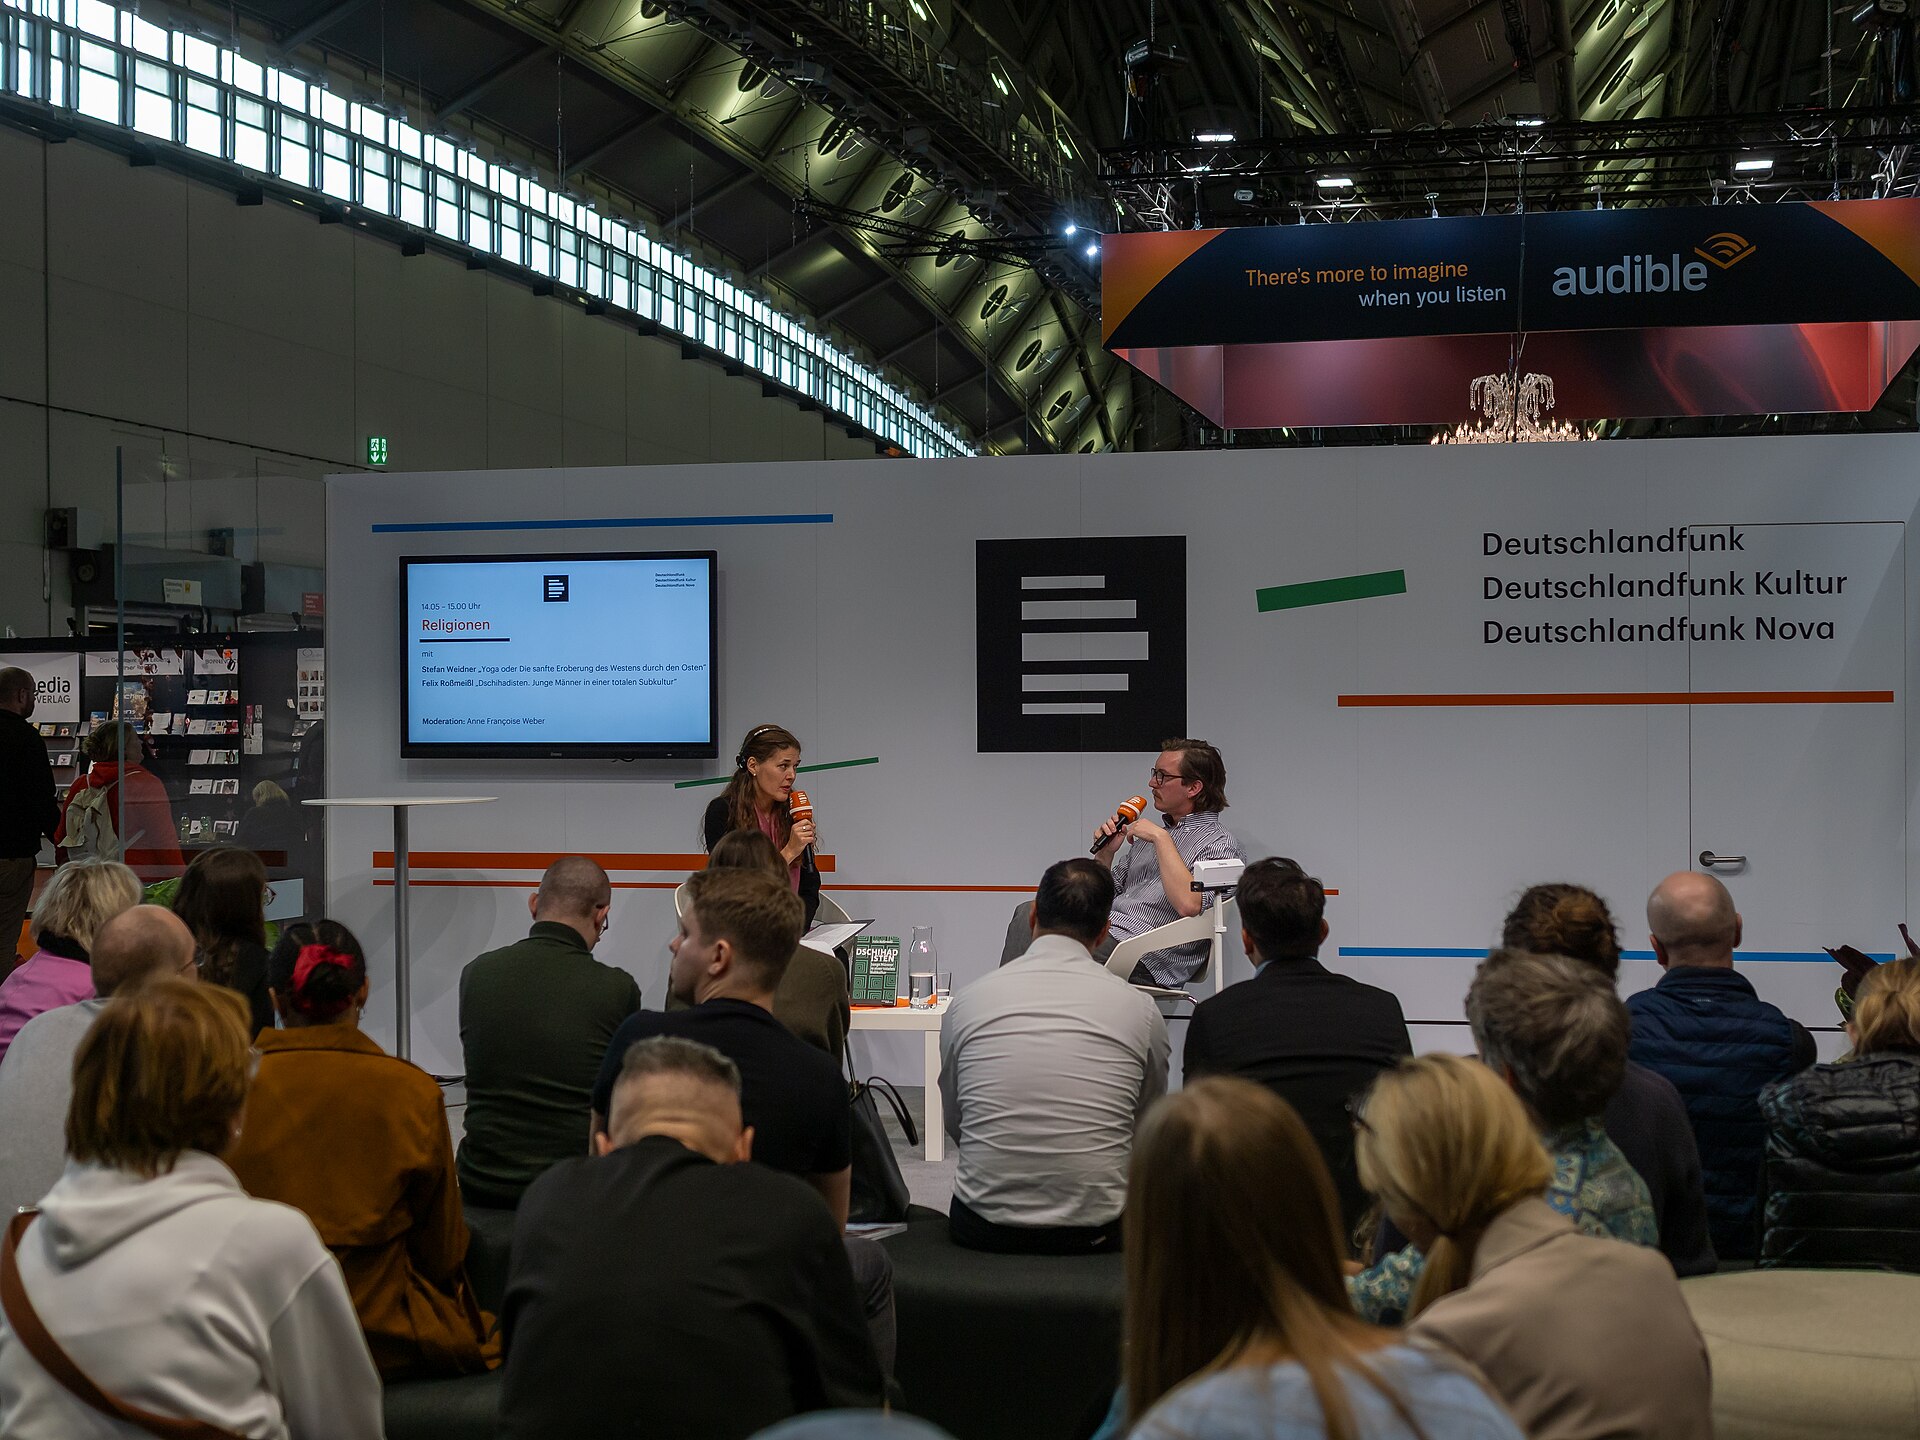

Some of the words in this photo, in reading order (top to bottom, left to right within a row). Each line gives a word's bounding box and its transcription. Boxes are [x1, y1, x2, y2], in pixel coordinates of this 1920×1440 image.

[1246, 268, 1310, 286] There's
[1317, 269, 1364, 283] more
[1370, 266, 1387, 280] to
[1394, 262, 1467, 282] imagine
[1552, 254, 1708, 297] audible
[1359, 290, 1409, 306] when
[1417, 291, 1449, 308] you
[1457, 286, 1505, 302] listen
[1483, 526, 1745, 556] Deutschlandfunk
[1483, 570, 1746, 600] Deutschlandfunk
[1756, 570, 1847, 595] Kultur
[422, 603, 440, 611] 14.05
[448, 602, 466, 611] 15.00
[469, 602, 480, 610] Uhr
[422, 618, 490, 634] Religionen
[1483, 616, 1746, 644] Deutschlandfunk
[1756, 617, 1833, 640] Nova
[422, 650, 433, 658] mit
[422, 665, 444, 673] Stefan
[447, 665, 476, 673] Weidner
[501, 664, 517, 673] oder
[520, 665, 531, 673] Die
[533, 664, 554, 673] sanfte
[557, 664, 593, 674] Eroberung
[596, 664, 608, 672] des
[610, 664, 640, 672] Westens
[642, 663, 663, 672] durch
[666, 663, 679, 672] den
[422, 679, 438, 687] Felix
[532, 679, 553, 688] Junge
[555, 678, 581, 687] Männer
[584, 678, 590, 686] in
[592, 678, 609, 686] einer
[612, 678, 637, 686] totalen
[36, 694, 71, 704] VERLAG
[423, 717, 465, 725] Moderation:
[467, 717, 485, 725] Anne
[487, 717, 520, 727] Françoise
[522, 716, 545, 725] Weber
[856, 948, 899, 956] DSCHIHAD
